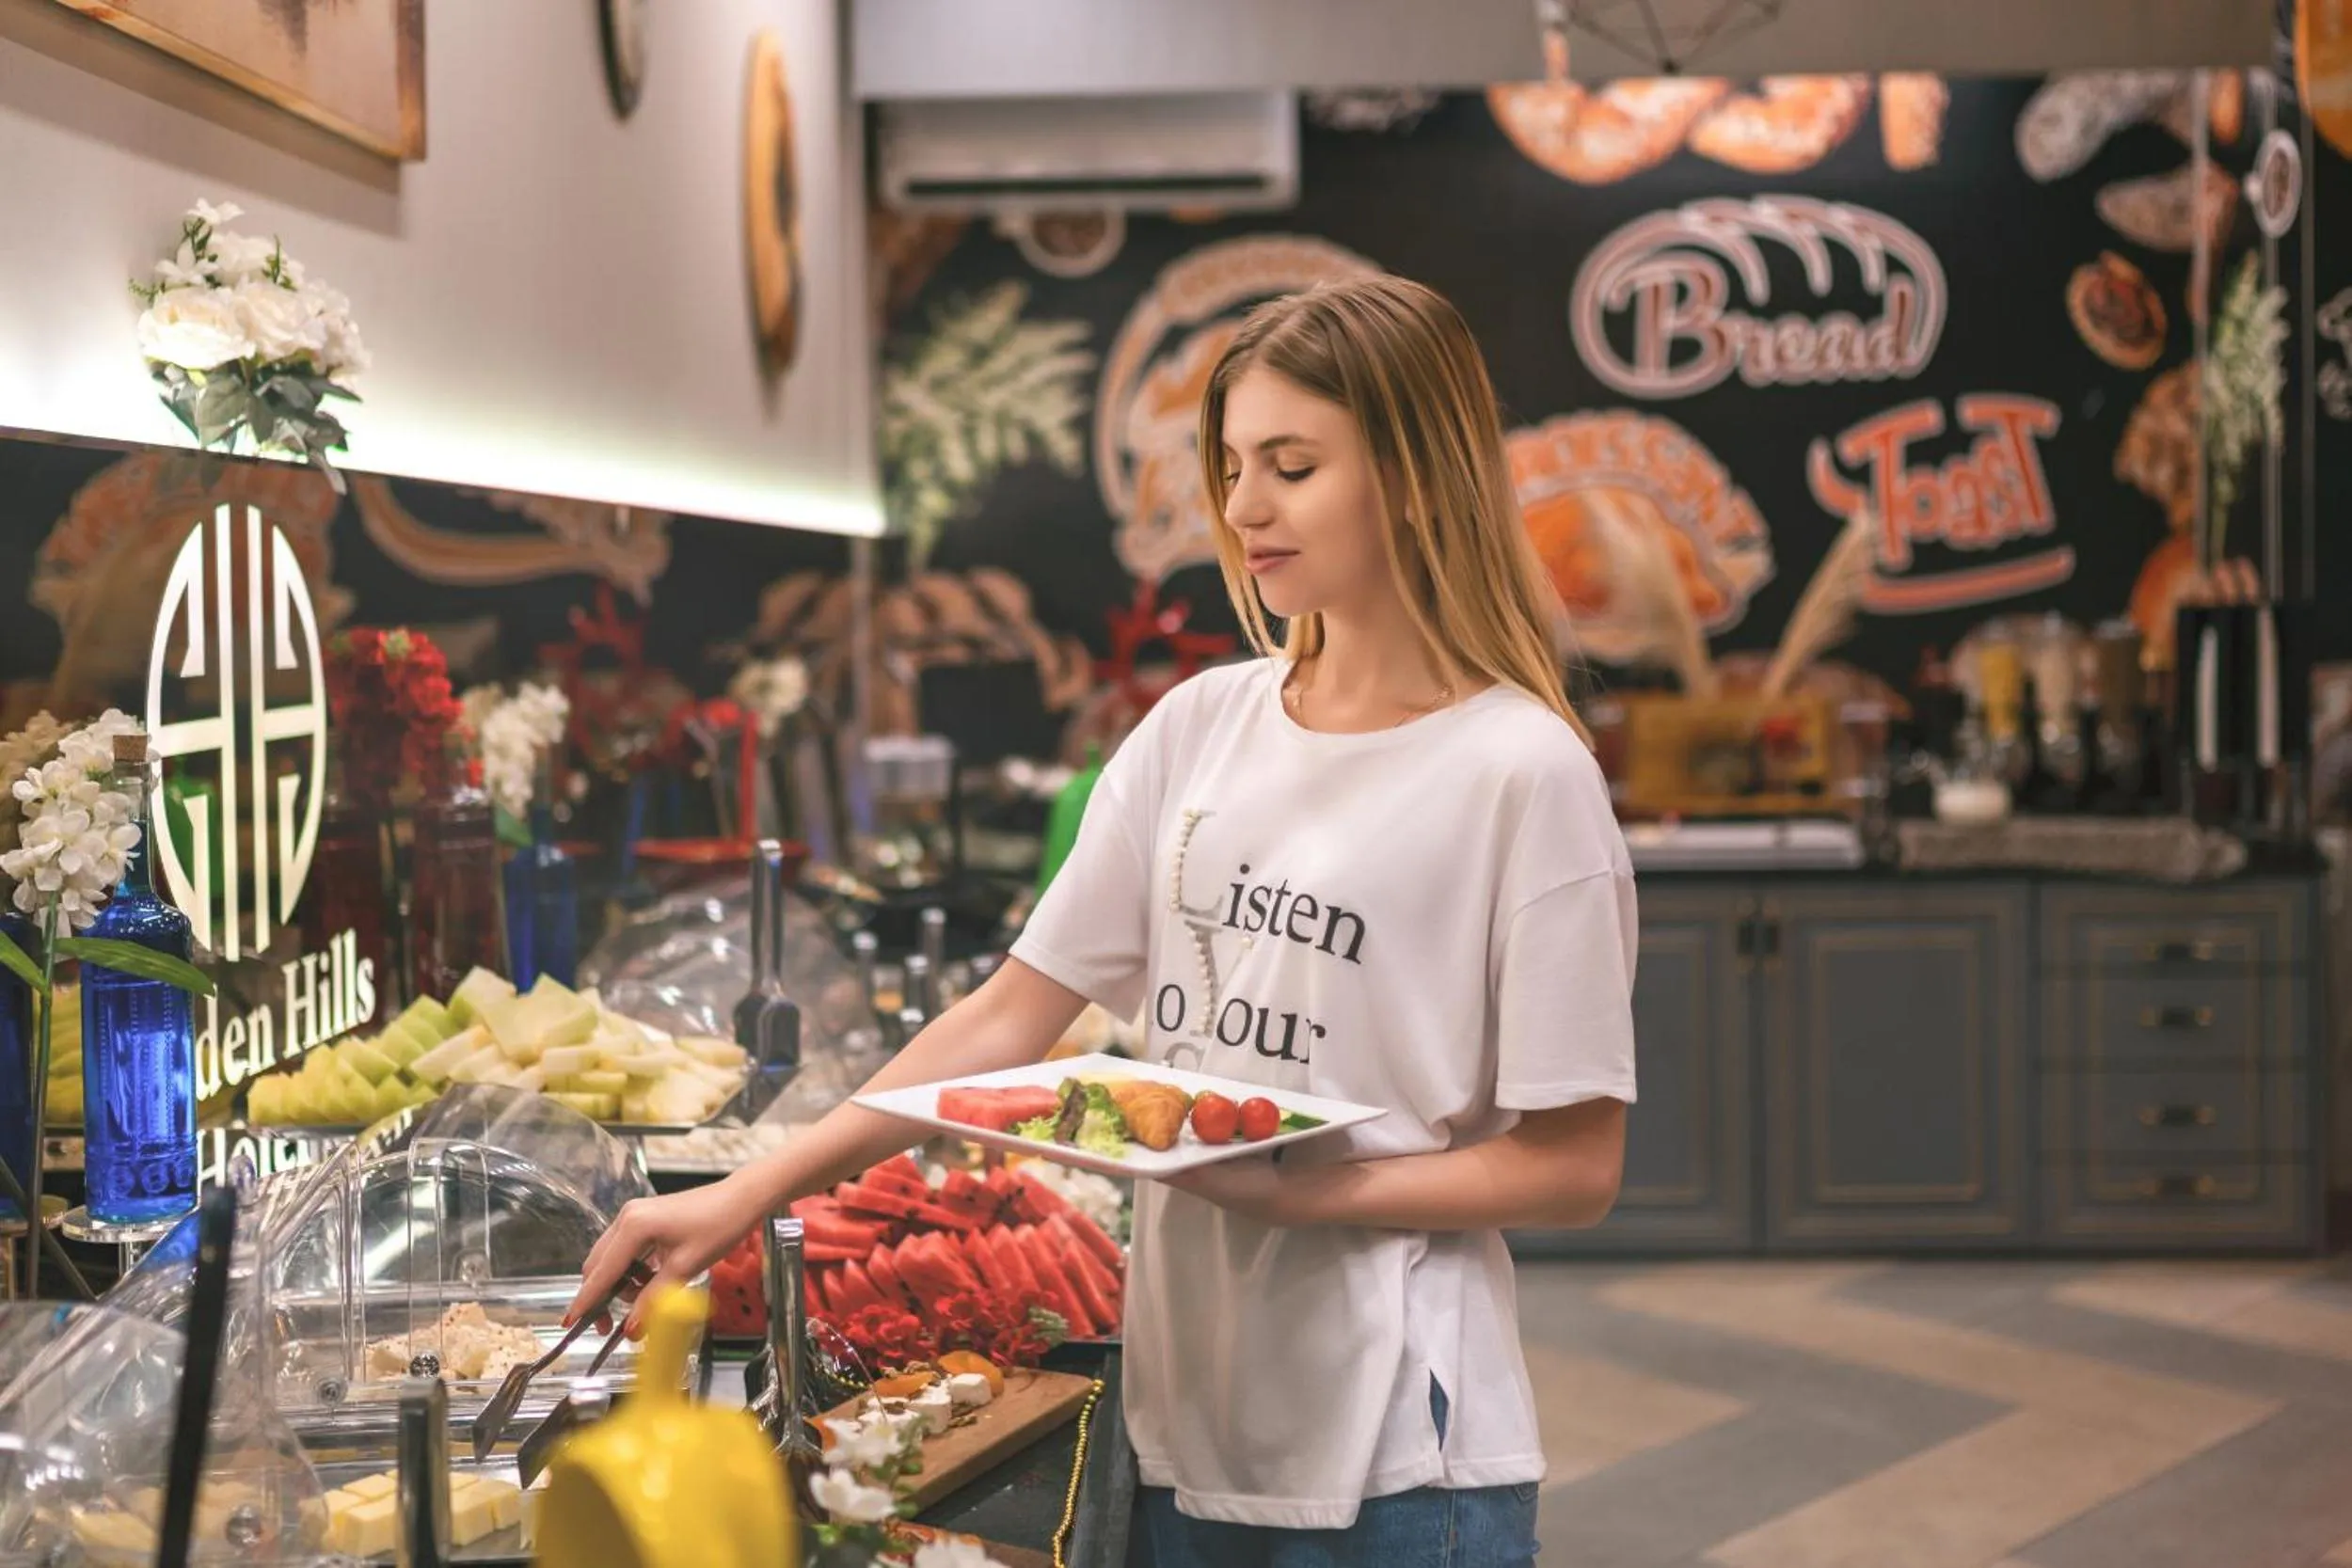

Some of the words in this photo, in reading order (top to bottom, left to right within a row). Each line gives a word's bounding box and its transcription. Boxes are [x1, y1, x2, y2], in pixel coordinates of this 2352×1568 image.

[1599, 248, 1923, 388] Bread
[1169, 808, 1367, 965] Listen
[281, 927, 376, 1059] Hills
[1151, 983, 1186, 1032] o
[1183, 919, 1327, 1065] Your
